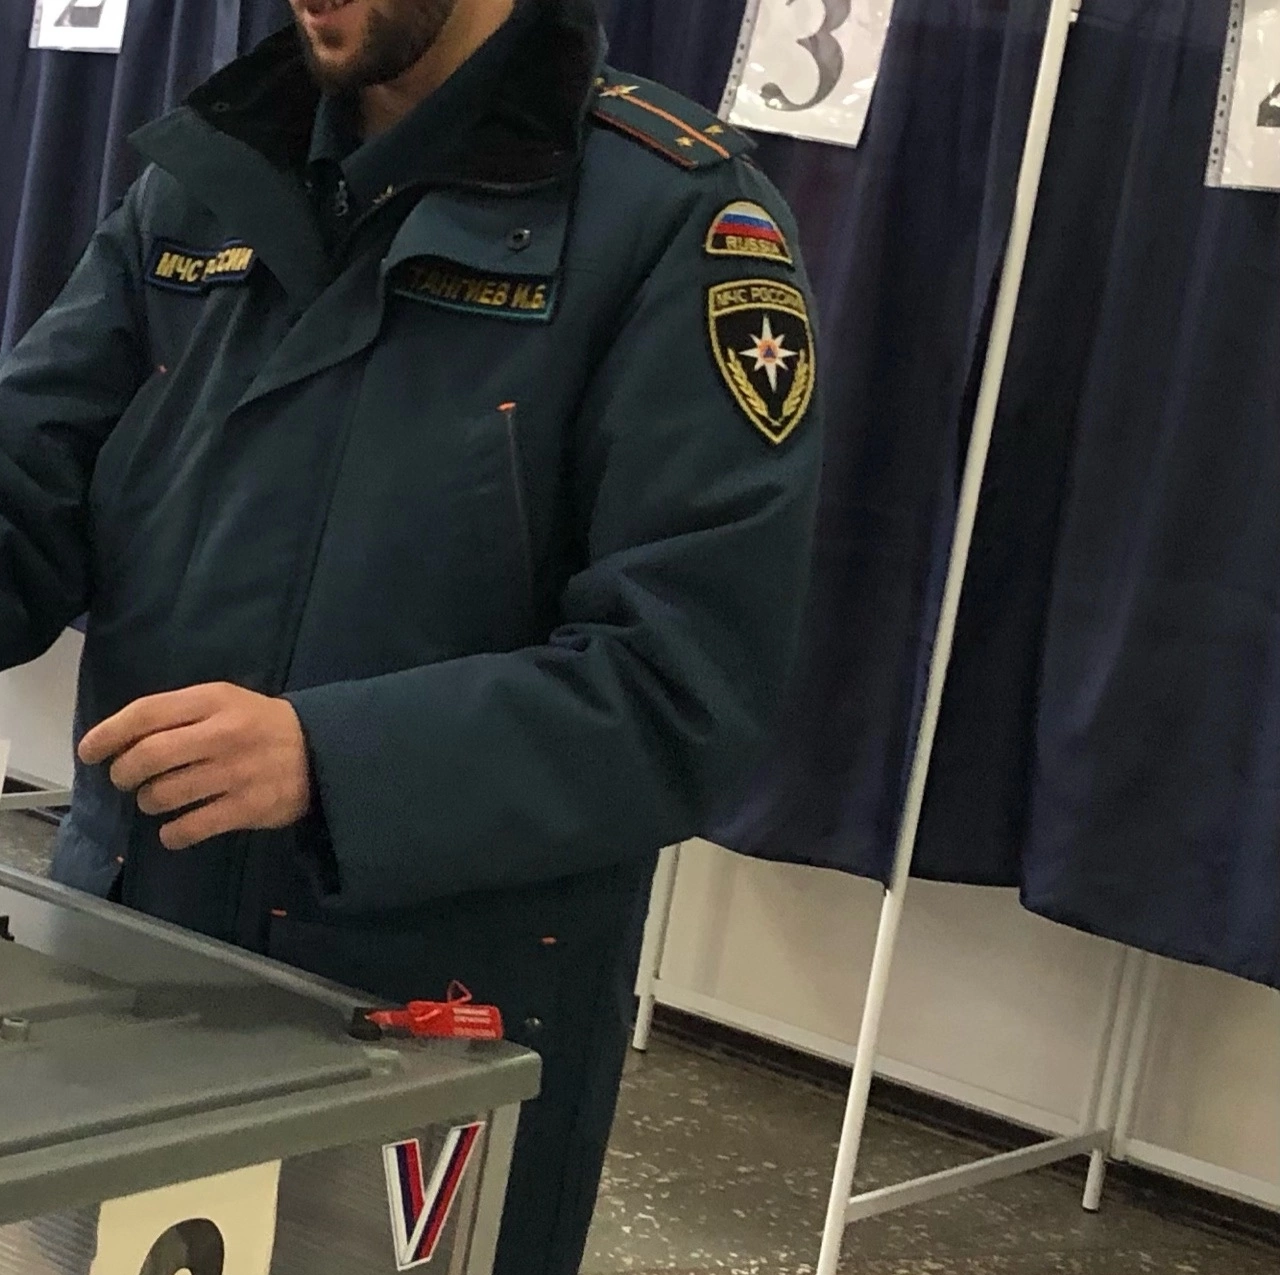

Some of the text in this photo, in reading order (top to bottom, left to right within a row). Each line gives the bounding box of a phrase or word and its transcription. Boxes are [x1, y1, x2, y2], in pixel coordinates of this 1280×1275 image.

[760, 0, 851, 112] 3
[725, 235, 781, 256] RUSSIA
[155, 251, 204, 282] МЧС
